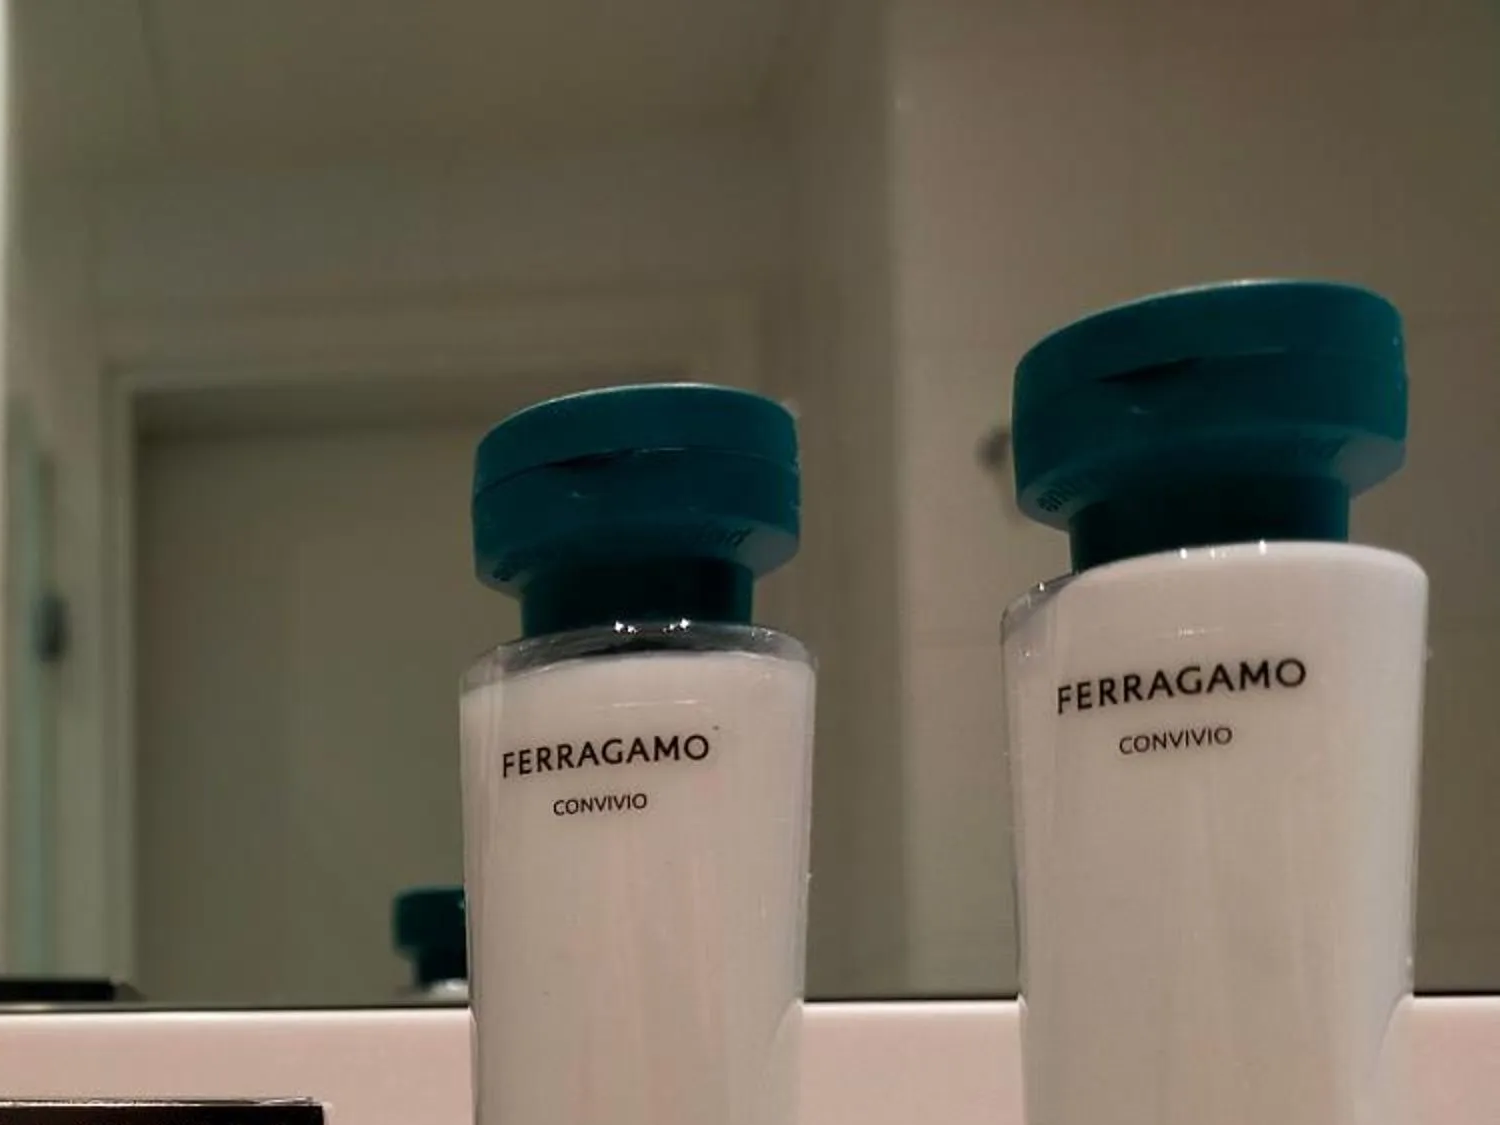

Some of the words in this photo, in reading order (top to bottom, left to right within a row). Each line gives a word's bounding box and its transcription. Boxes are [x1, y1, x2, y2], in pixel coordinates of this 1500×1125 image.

[1057, 658, 1307, 715] FERRAGAMO
[502, 734, 710, 778] FERRAGAMO
[1118, 727, 1233, 755] CONVIVIO
[553, 793, 648, 816] CONVIVIO
